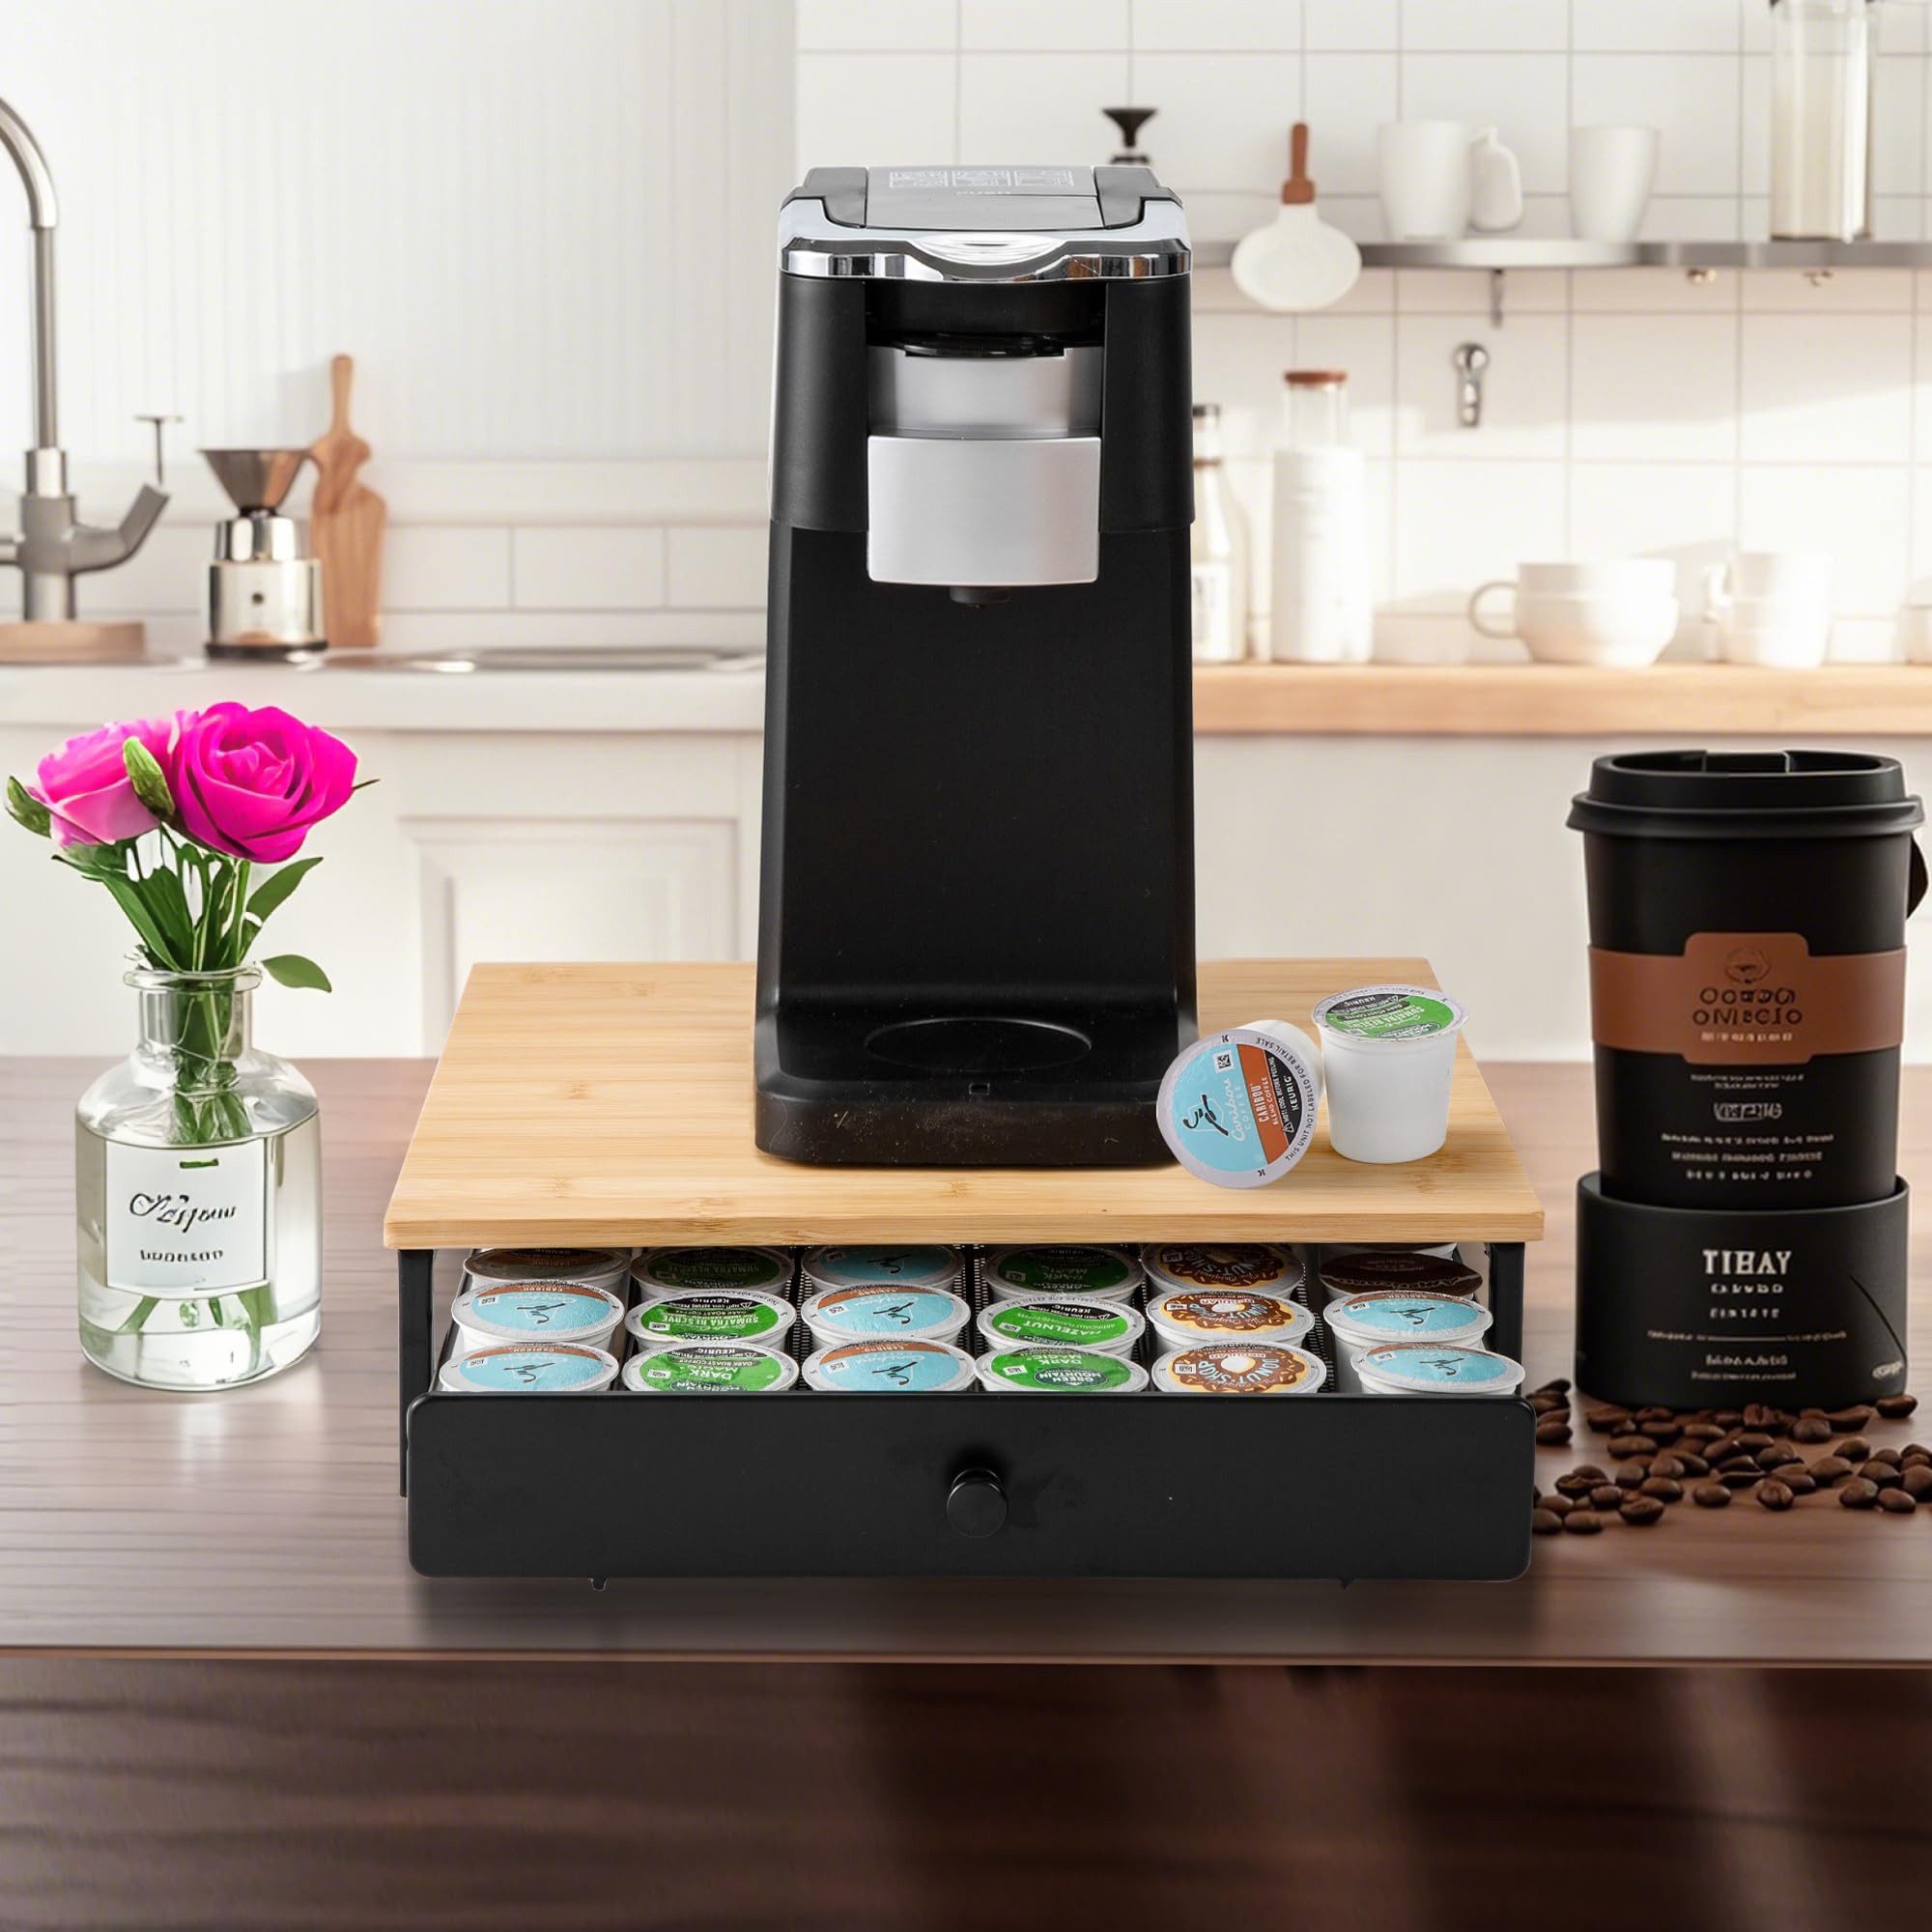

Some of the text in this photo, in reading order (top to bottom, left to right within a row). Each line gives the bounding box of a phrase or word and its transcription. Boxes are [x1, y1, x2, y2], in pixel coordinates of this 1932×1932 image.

[1383, 1006, 1425, 1023] SUMATRA
[1256, 1037, 1274, 1048] SALE
[1275, 1044, 1295, 1065] RETAIL
[1294, 1065, 1306, 1078] FOR
[1262, 1077, 1278, 1125] BLEND COFFEE
[1284, 1076, 1298, 1111] KEURIG
[1303, 1080, 1314, 1111] LABELED
[1251, 1085, 1269, 1122] CARIBOU
[1278, 1096, 1287, 1110] COOL
[1299, 1130, 1310, 1146] UNIT
[1285, 1148, 1300, 1161] THIS
[662, 1315, 758, 1325] SUMATRA RESERVE
[1023, 1320, 1101, 1335] HAZELNUT
[689, 1369, 732, 1380] DARK
